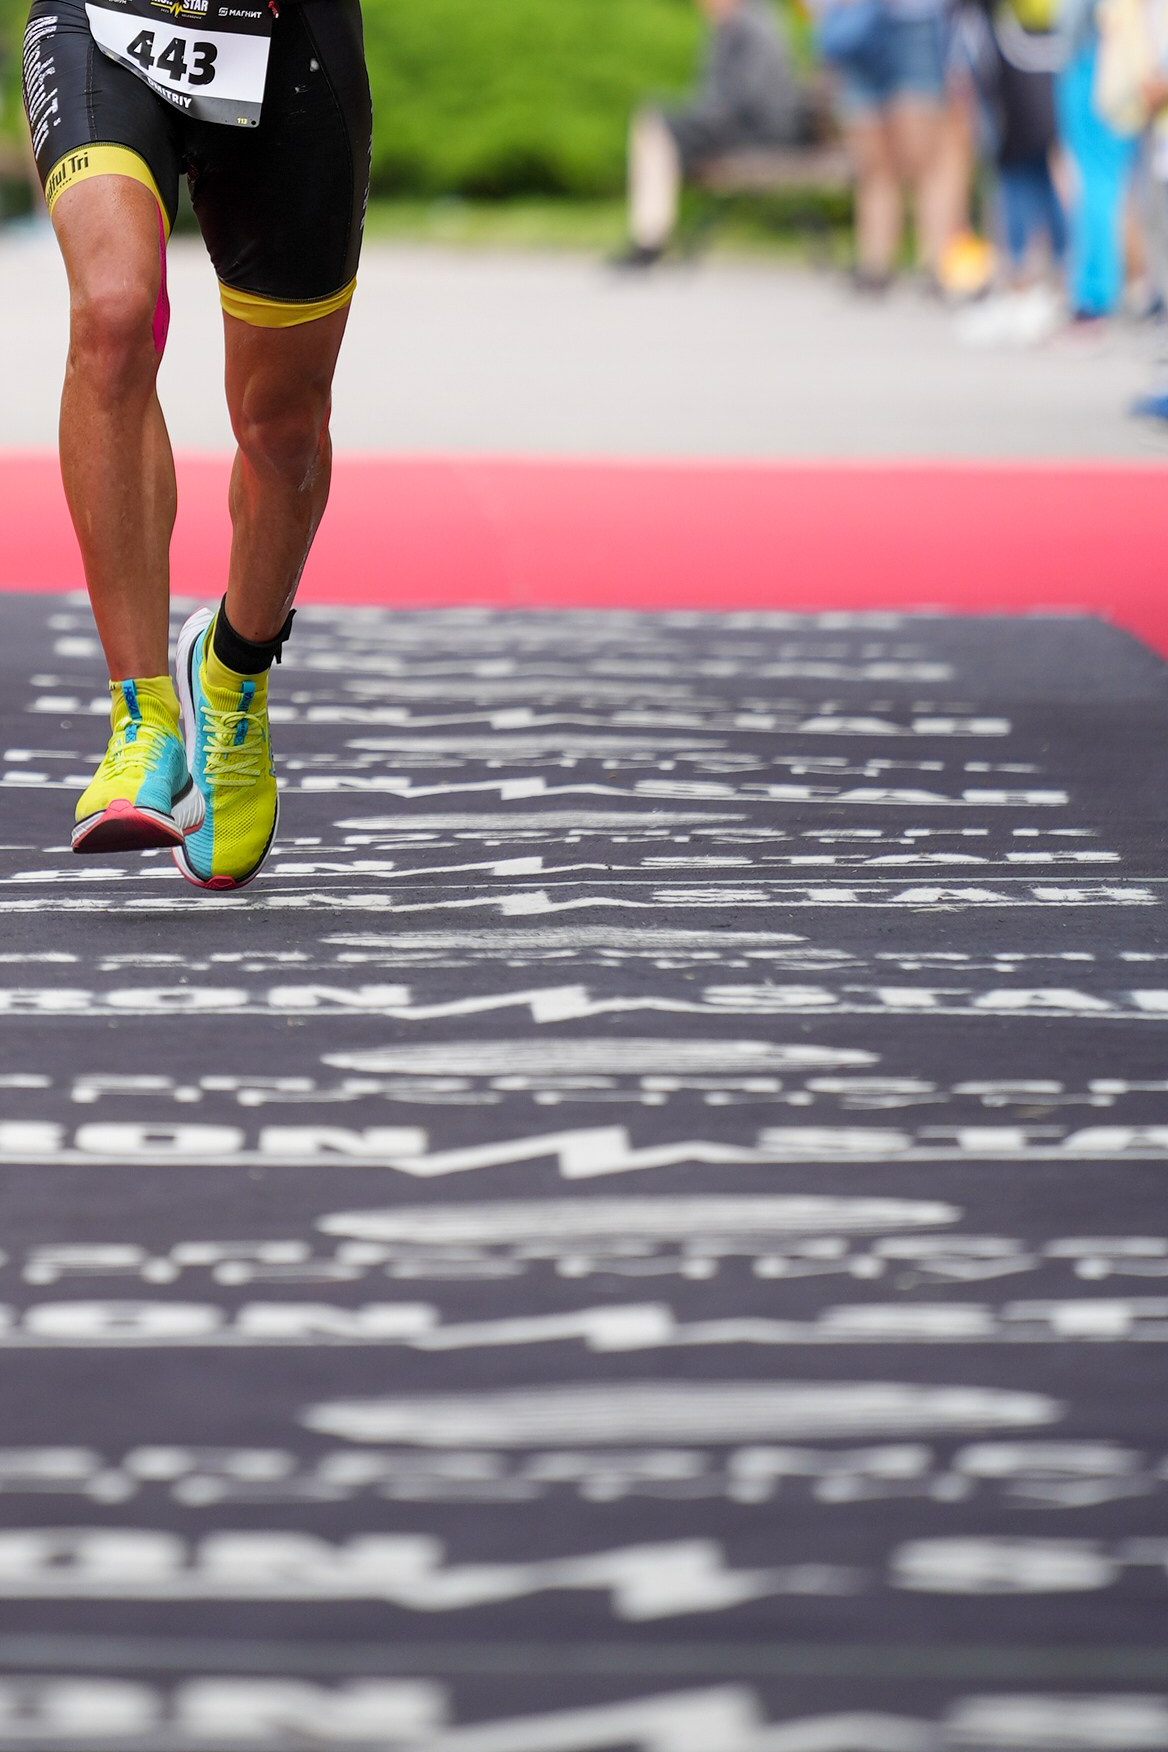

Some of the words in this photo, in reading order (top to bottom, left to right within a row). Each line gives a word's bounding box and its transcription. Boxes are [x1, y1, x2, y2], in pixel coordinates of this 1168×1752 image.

[229, 9, 262, 19] МАГНИТ
[127, 29, 218, 85] 443
[147, 76, 193, 108] DMITRIY
[68, 152, 89, 173] Tri
[632, 778, 1070, 804] STAR
[640, 851, 1121, 866] STAR
[652, 887, 1157, 903] STAR
[702, 984, 1168, 1009] STA
